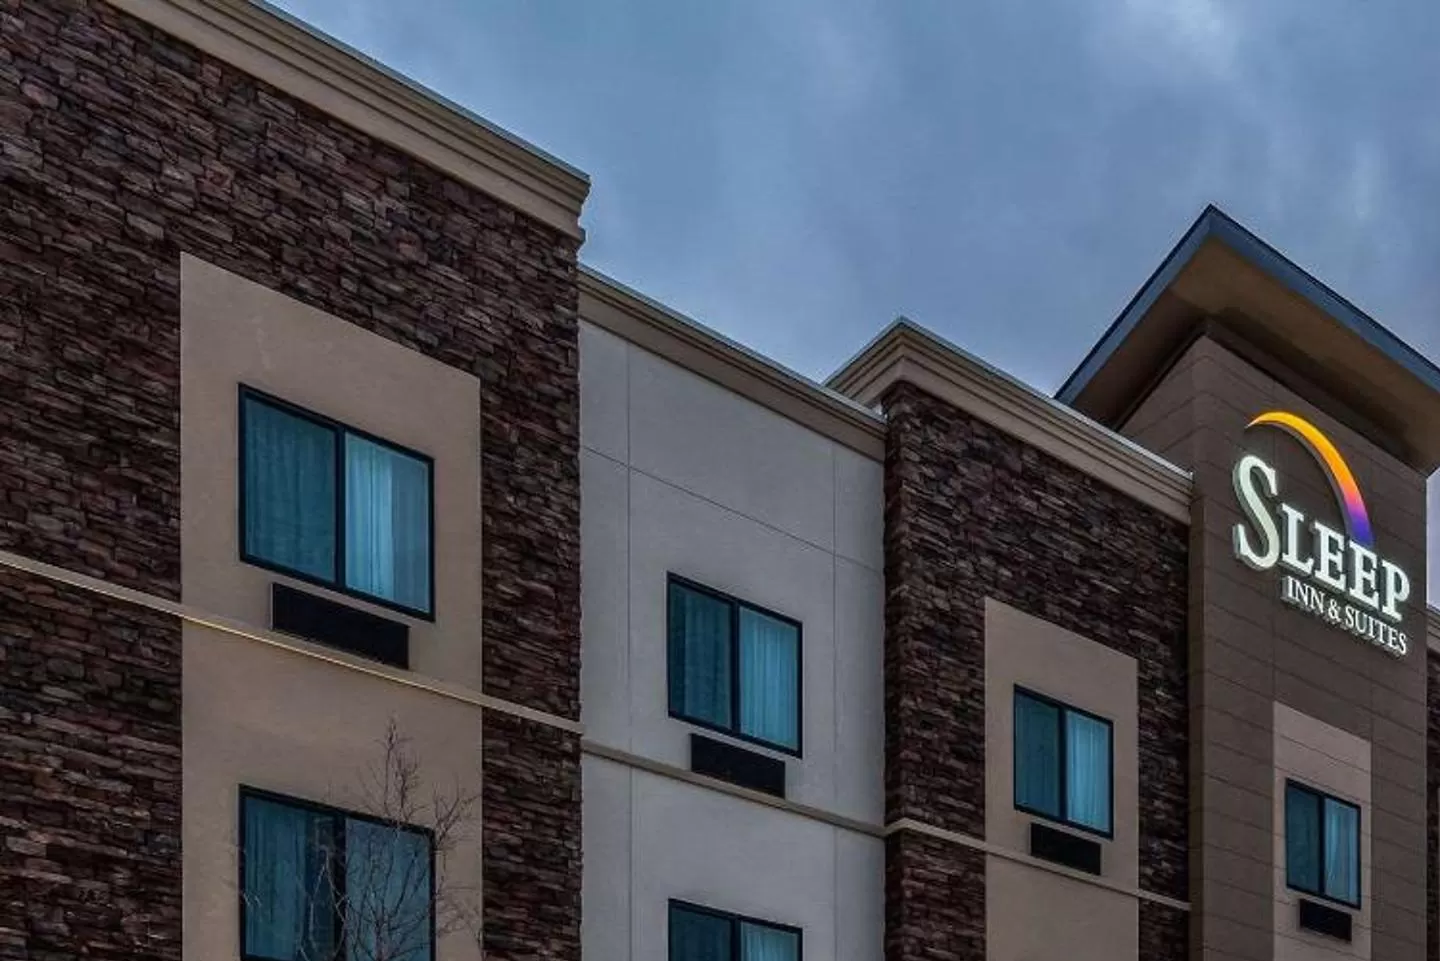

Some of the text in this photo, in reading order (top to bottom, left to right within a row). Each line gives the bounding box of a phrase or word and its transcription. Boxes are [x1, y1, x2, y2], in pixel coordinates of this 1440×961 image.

[1233, 455, 1410, 622] SLEEP
[1284, 576, 1407, 655] INN & SUITES
